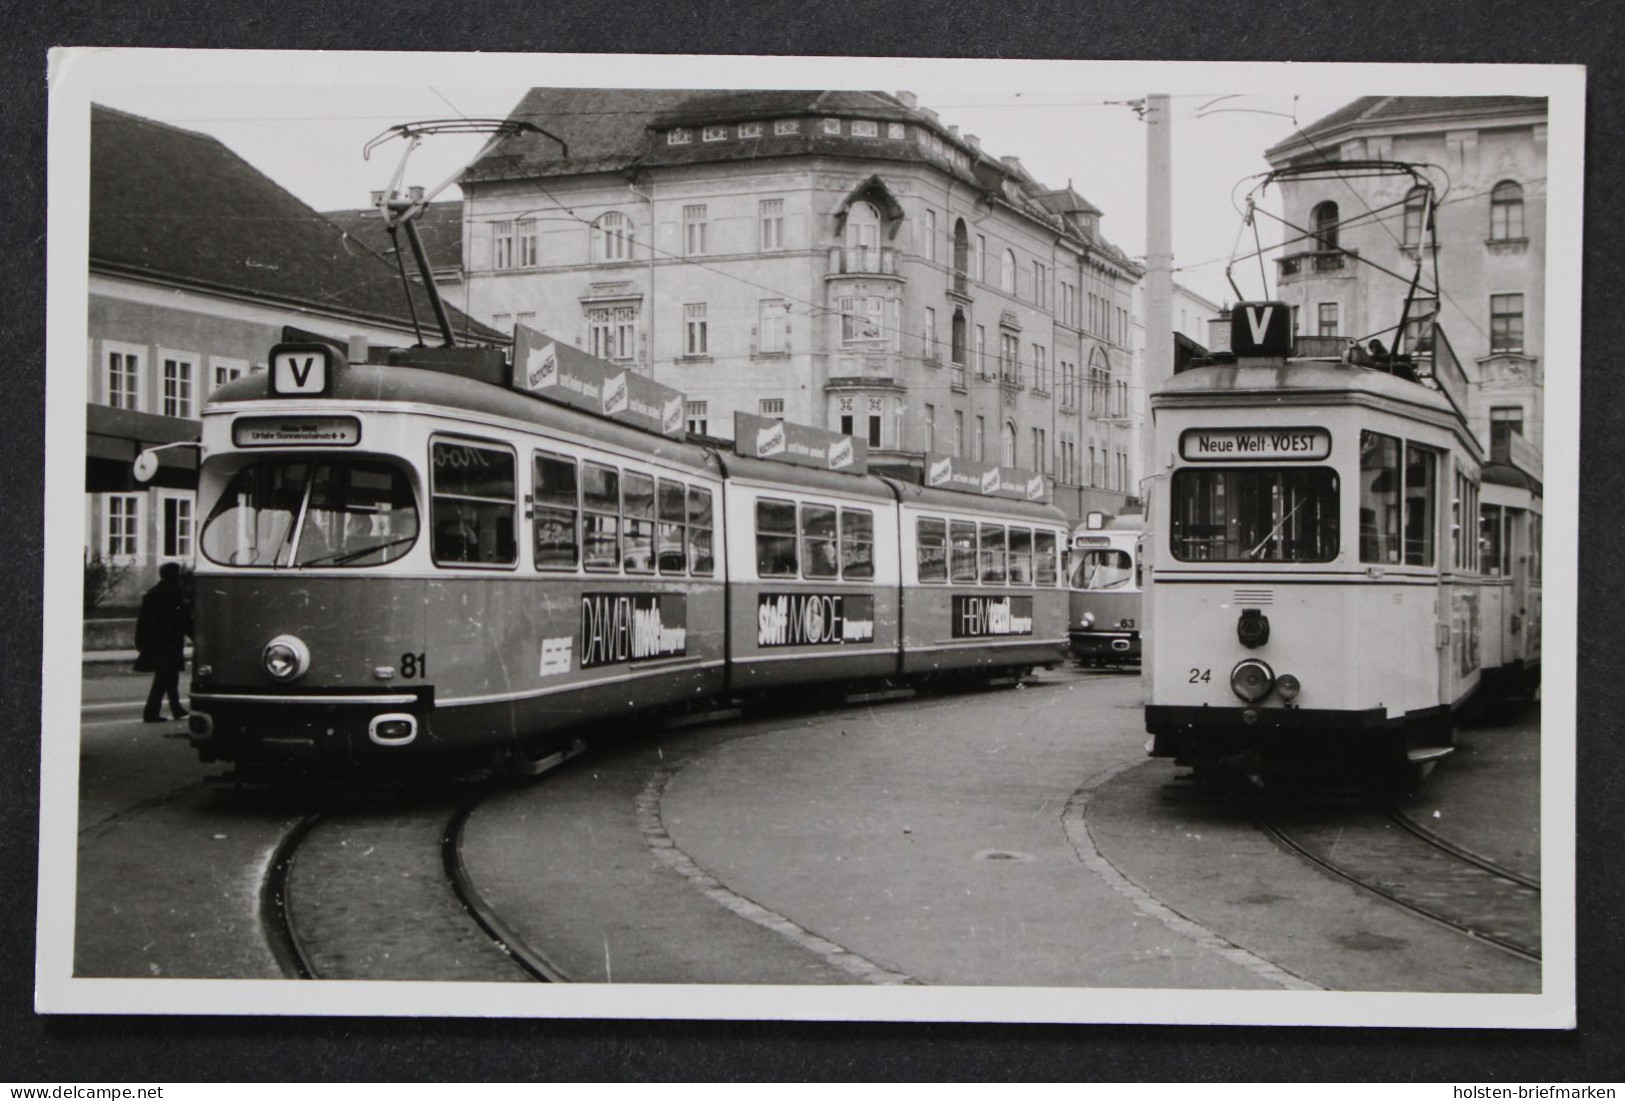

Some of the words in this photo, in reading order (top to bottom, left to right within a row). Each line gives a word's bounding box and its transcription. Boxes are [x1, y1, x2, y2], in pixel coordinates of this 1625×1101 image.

[1246, 306, 1273, 345] V
[288, 357, 314, 388] V
[1199, 436, 1233, 452] Neue
[1120, 618, 1135, 629] 63
[400, 652, 426, 679] 81
[1188, 668, 1211, 684] 24
